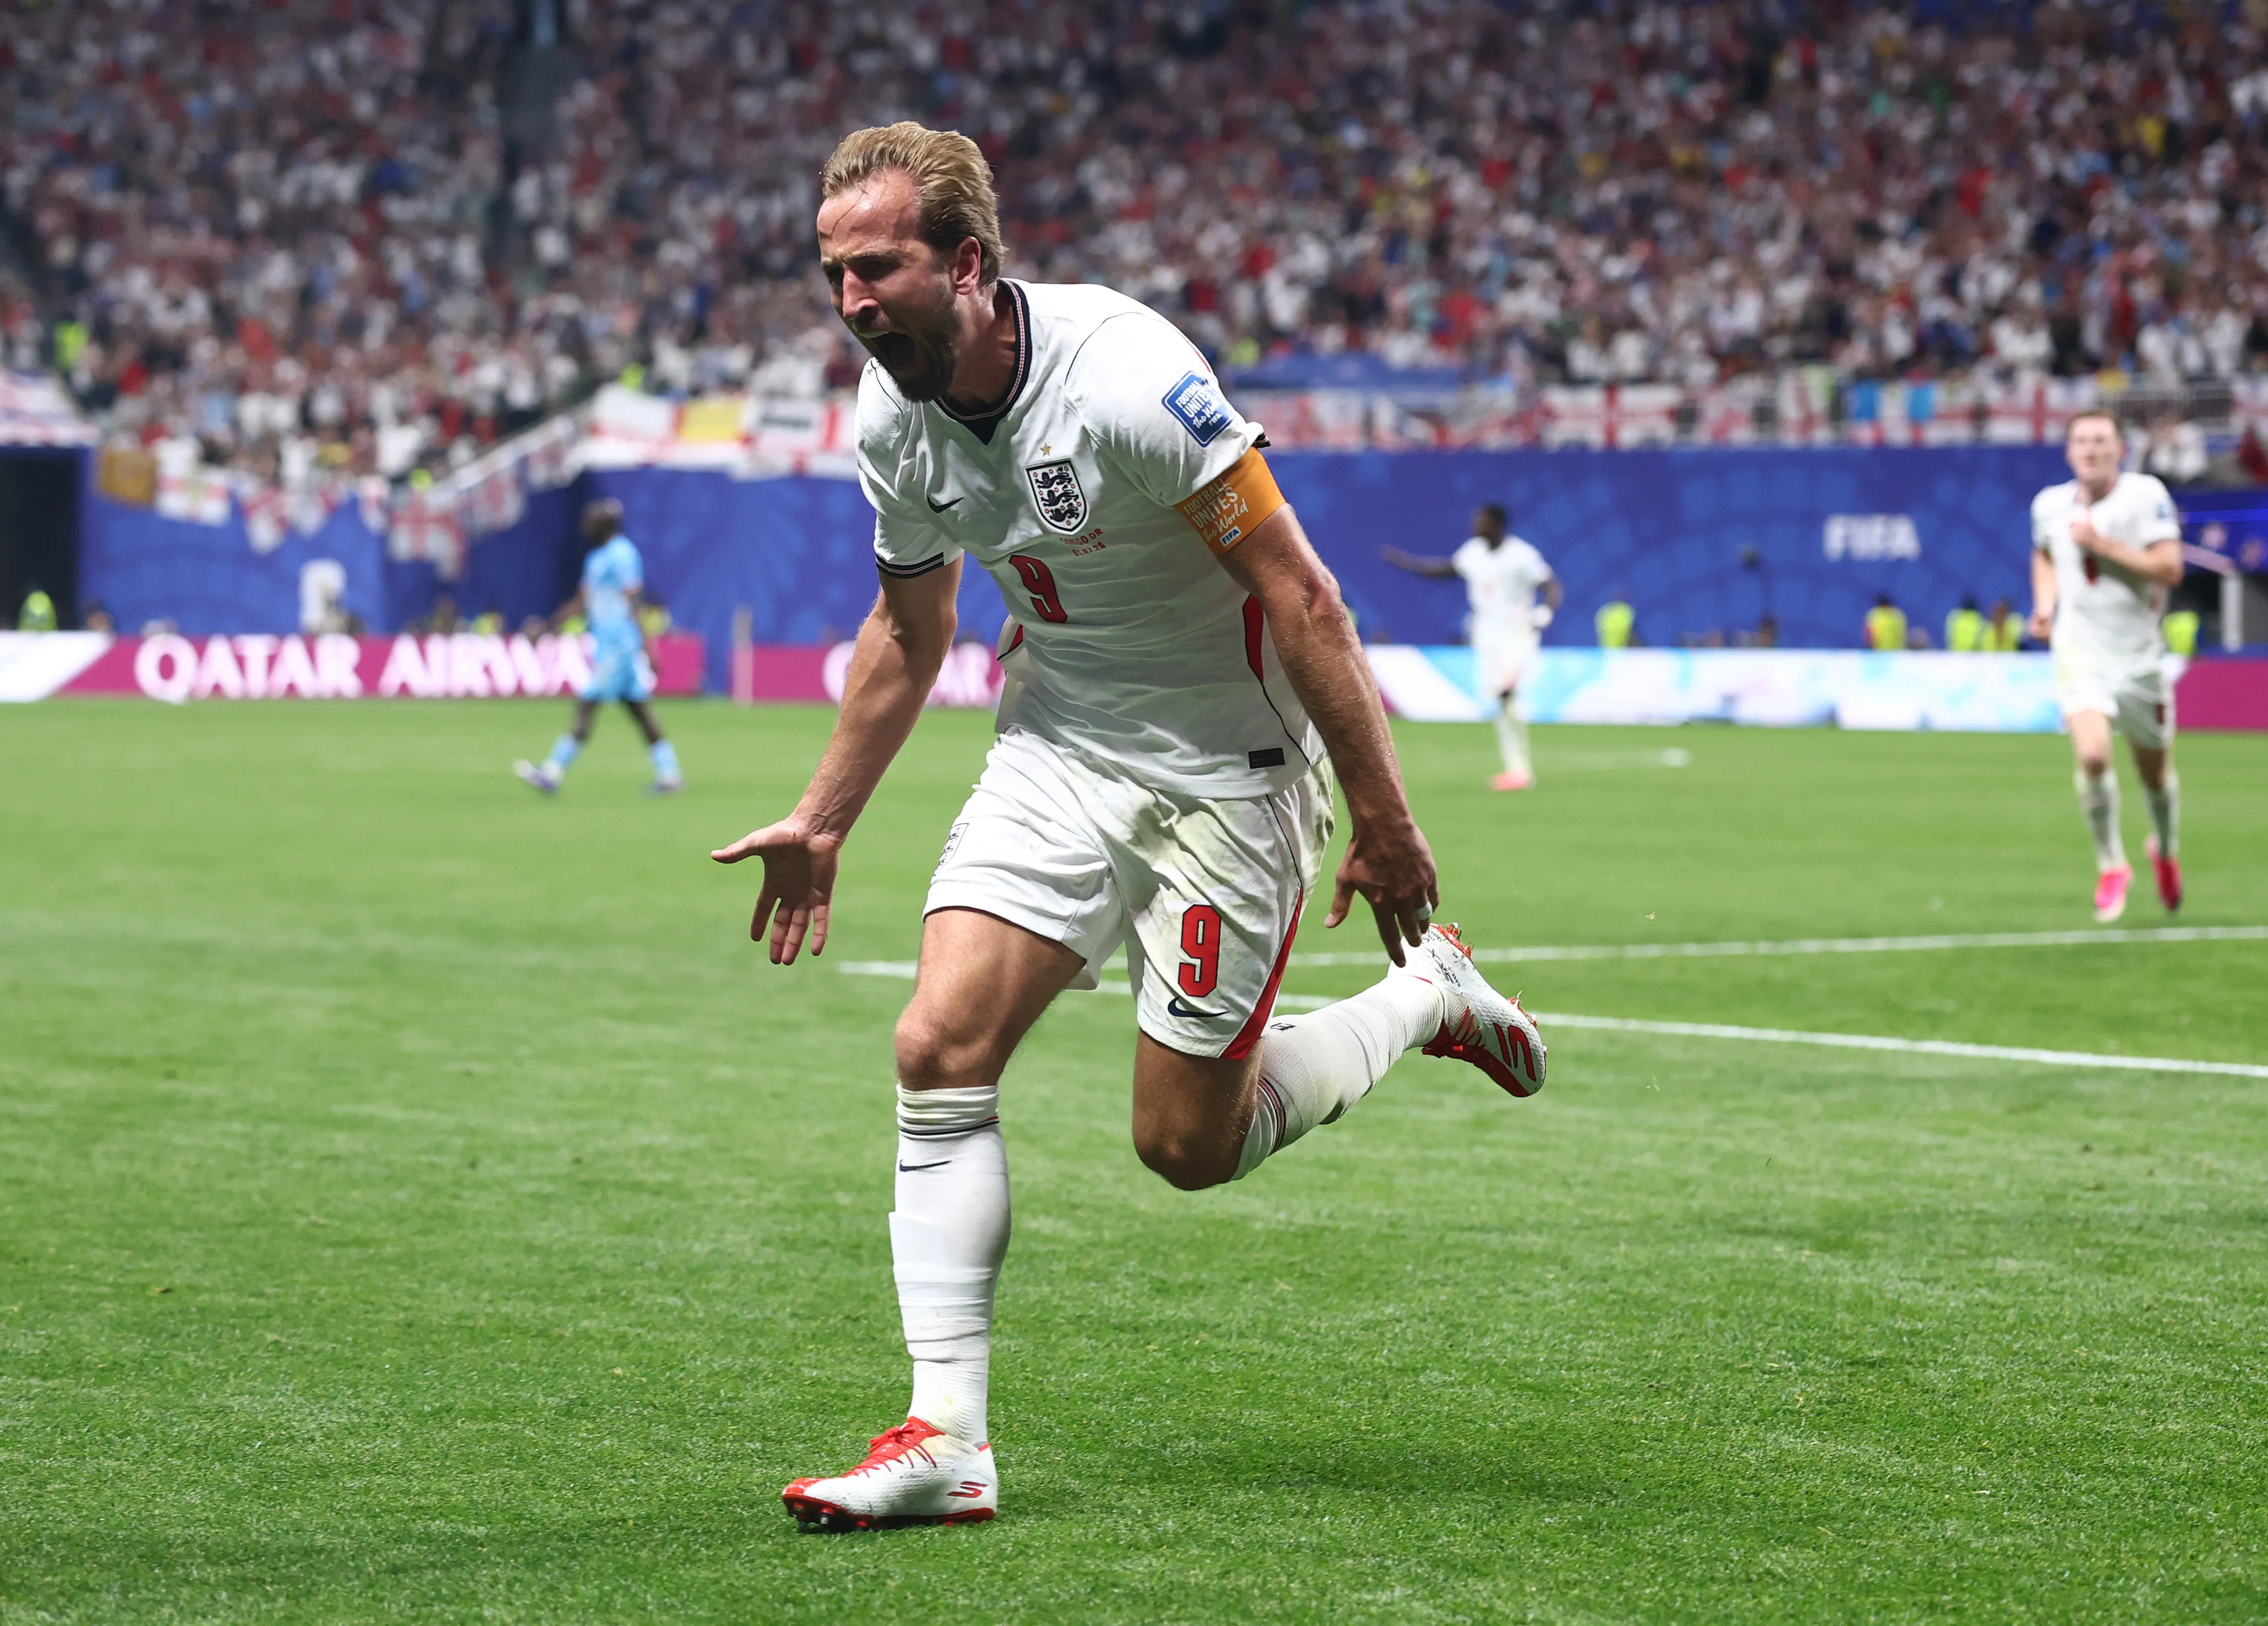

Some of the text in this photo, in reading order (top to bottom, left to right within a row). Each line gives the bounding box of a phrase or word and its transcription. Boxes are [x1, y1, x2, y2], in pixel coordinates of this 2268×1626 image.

[1175, 380, 1202, 408] FOOTBALL
[1192, 414, 1206, 429] the
[1208, 412, 1222, 426] FIFA
[1183, 477, 1229, 515] FOOTBALL
[1191, 486, 1238, 529] UNITES
[1088, 528, 1104, 540] DR
[1202, 498, 1249, 542] the World
[1222, 529, 1240, 545] FIFA
[1822, 513, 1922, 563] FIFA
[1008, 554, 1068, 623] 9
[135, 633, 655, 703] QATAR AIRWA
[1177, 904, 1222, 998] 9
